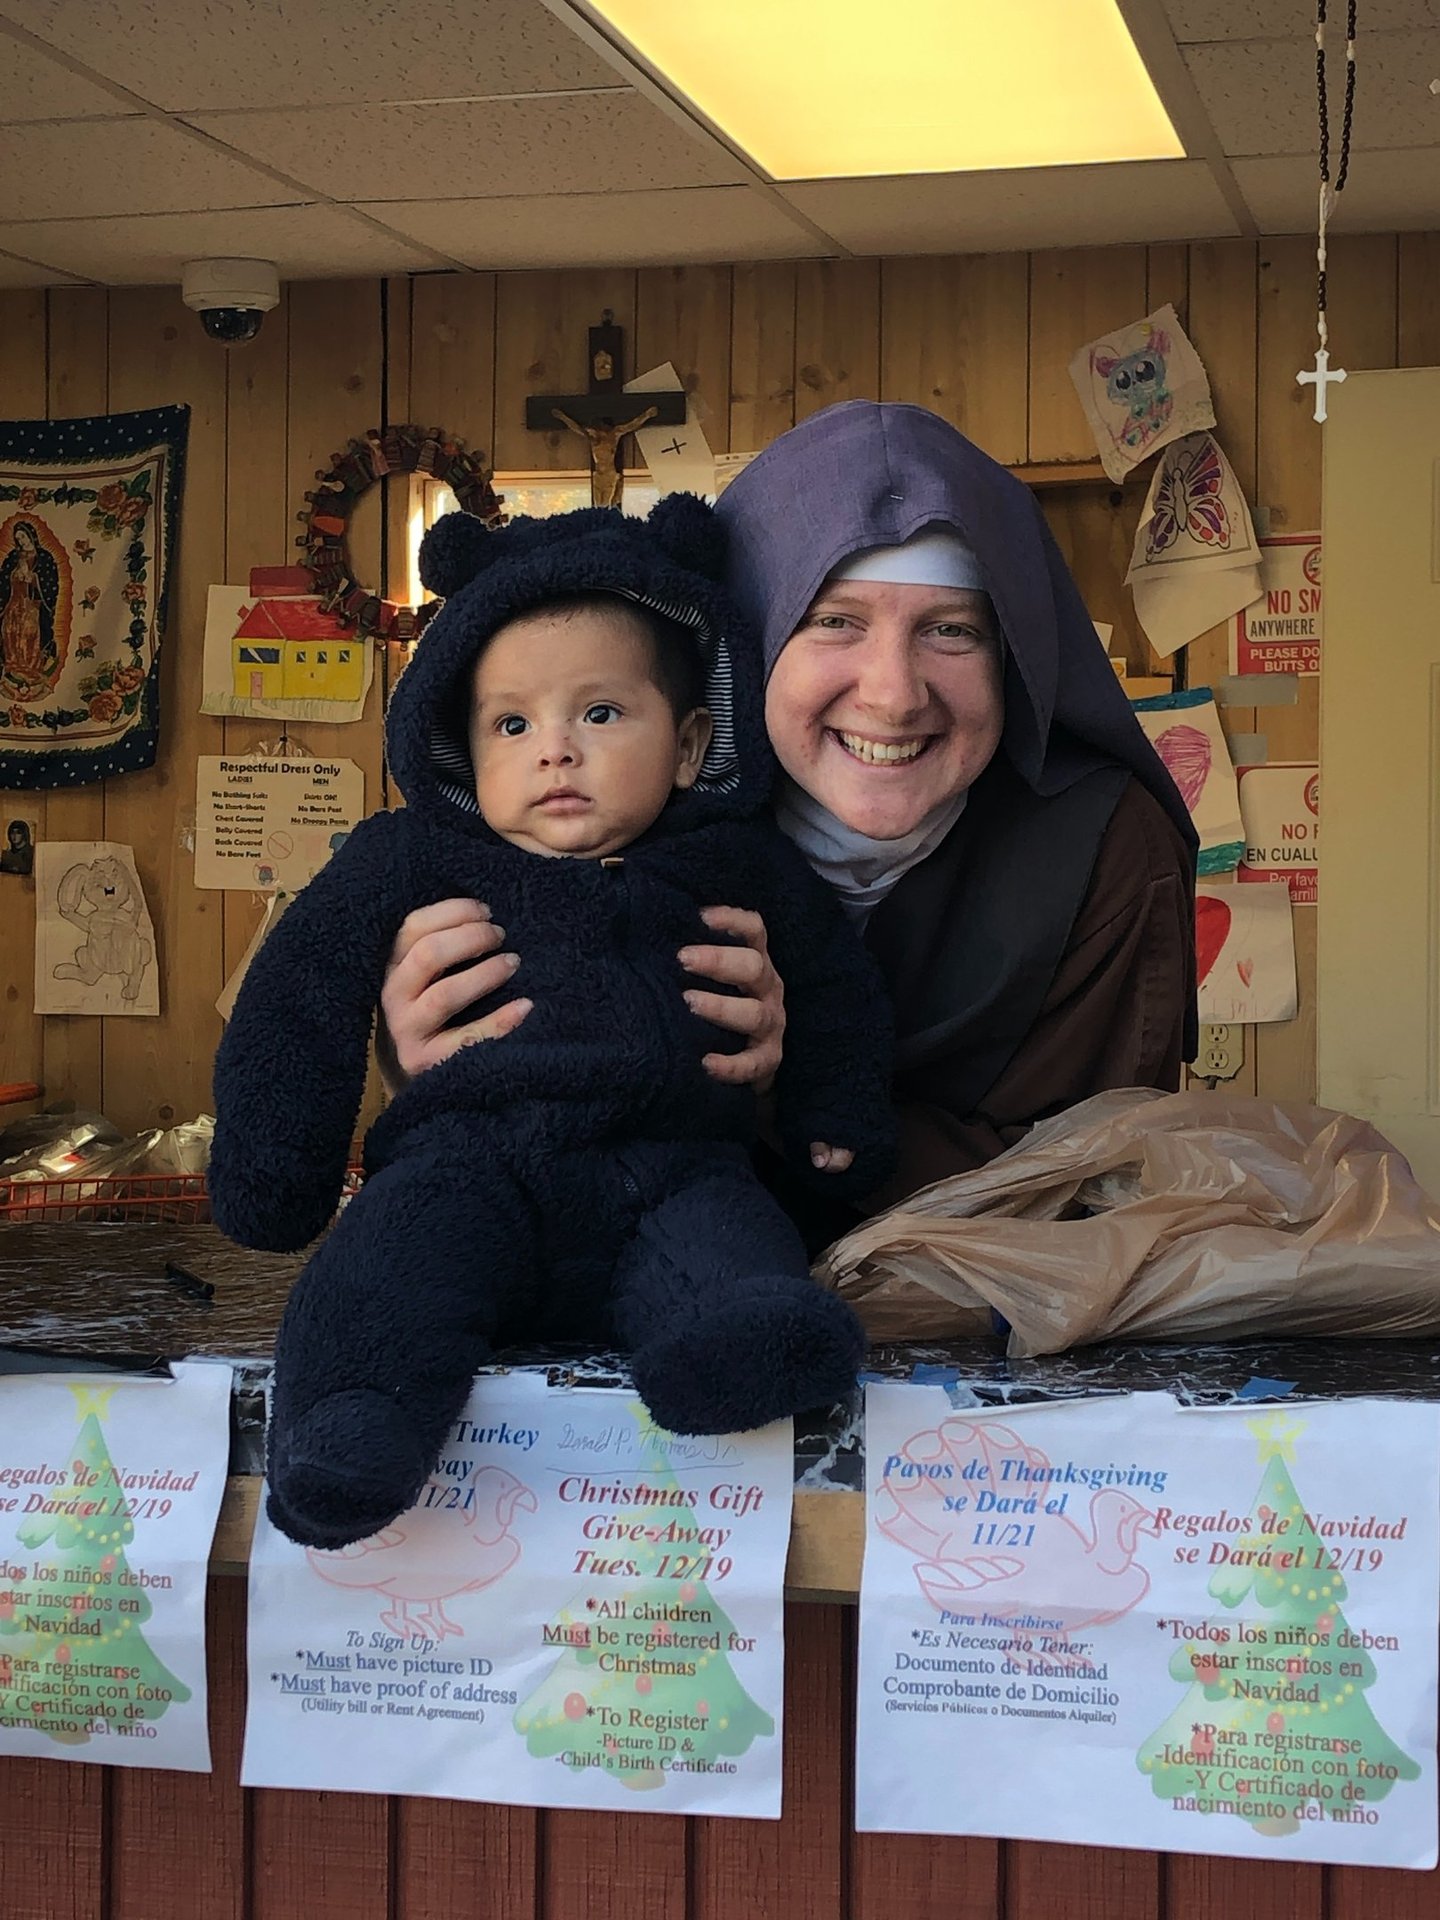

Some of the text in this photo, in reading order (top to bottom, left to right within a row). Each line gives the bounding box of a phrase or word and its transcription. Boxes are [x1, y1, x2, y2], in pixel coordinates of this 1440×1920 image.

[1267, 590, 1291, 615] NO
[1250, 618, 1315, 637] ANYWHERE
[1250, 647, 1299, 660] PLEASE
[1264, 659, 1320, 672] BUTTS O
[220, 762, 341, 777] Respectful Dress Only
[1282, 824, 1307, 840] NO
[1246, 848, 1266, 862] EN
[1270, 872, 1292, 884] Por
[456, 1421, 539, 1451] Turkey
[73, 1466, 100, 1487] de
[103, 1467, 200, 1492] Navidad
[883, 1455, 1168, 1493] Pavos de Thanksgiving
[22, 1493, 80, 1515] Dará
[83, 1496, 108, 1516] el
[111, 1498, 172, 1520] 12/19
[558, 1477, 765, 1517] Christmas Gift
[942, 1490, 1069, 1516] se Dará el
[582, 1515, 732, 1549] Give-Away
[972, 1522, 1036, 1547] 11/21
[1152, 1507, 1408, 1540] Regalos de Navidad
[573, 1550, 733, 1582] Tues. 12/19
[1173, 1542, 1384, 1572] se Dará el 12/19
[33, 1562, 58, 1582] los
[63, 1564, 113, 1585] niños
[118, 1569, 173, 1589] deben
[37, 1588, 113, 1612] inscritos
[118, 1598, 140, 1613] en
[633, 1603, 712, 1623] children
[24, 1615, 101, 1637] Navidad
[939, 1610, 1064, 1631] Para Inscribirse
[346, 1631, 440, 1655] To Sign Up:
[541, 1624, 756, 1652] Must be registered for
[946, 1631, 1034, 1652] Necesario
[1039, 1636, 1094, 1656] Tener:
[1238, 1622, 1268, 1644] los
[1274, 1626, 1331, 1647] niños
[1336, 1629, 1399, 1651] deben
[45, 1658, 141, 1681] registrarse
[356, 1653, 398, 1670] have
[403, 1655, 465, 1676] picture
[469, 1658, 493, 1676] ID
[599, 1653, 697, 1676] Christmas
[895, 1653, 1109, 1680] Documento de Identidad
[1190, 1651, 1363, 1677] estar inscritos en
[97, 1686, 129, 1699] con
[136, 1683, 173, 1702] foto
[331, 1676, 372, 1695] have
[377, 1679, 427, 1700] proof
[429, 1681, 450, 1700] of
[452, 1683, 518, 1705] address
[883, 1676, 1119, 1706] Comprobante de Domicilio
[1233, 1679, 1321, 1703] Navidad
[15, 1695, 117, 1718] Certificado
[123, 1703, 145, 1719] de
[301, 1699, 486, 1724] (Utility bill or Rent Agreement)
[885, 1699, 939, 1714] (Servicios
[991, 1707, 999, 1716] o
[1001, 1705, 1067, 1720] Documentos
[84, 1719, 111, 1735] del
[118, 1721, 157, 1739] niño
[628, 1709, 709, 1733] Register
[596, 1733, 695, 1752] -Picture ID &
[1254, 1728, 1362, 1754] registrarse
[554, 1751, 738, 1774] -Child's Birth Certificate
[1155, 1744, 1399, 1780] -Identificación con foto
[1218, 1771, 1333, 1800] Certificado
[1341, 1781, 1365, 1801] de
[1172, 1795, 1379, 1825] nacimiento del niño
